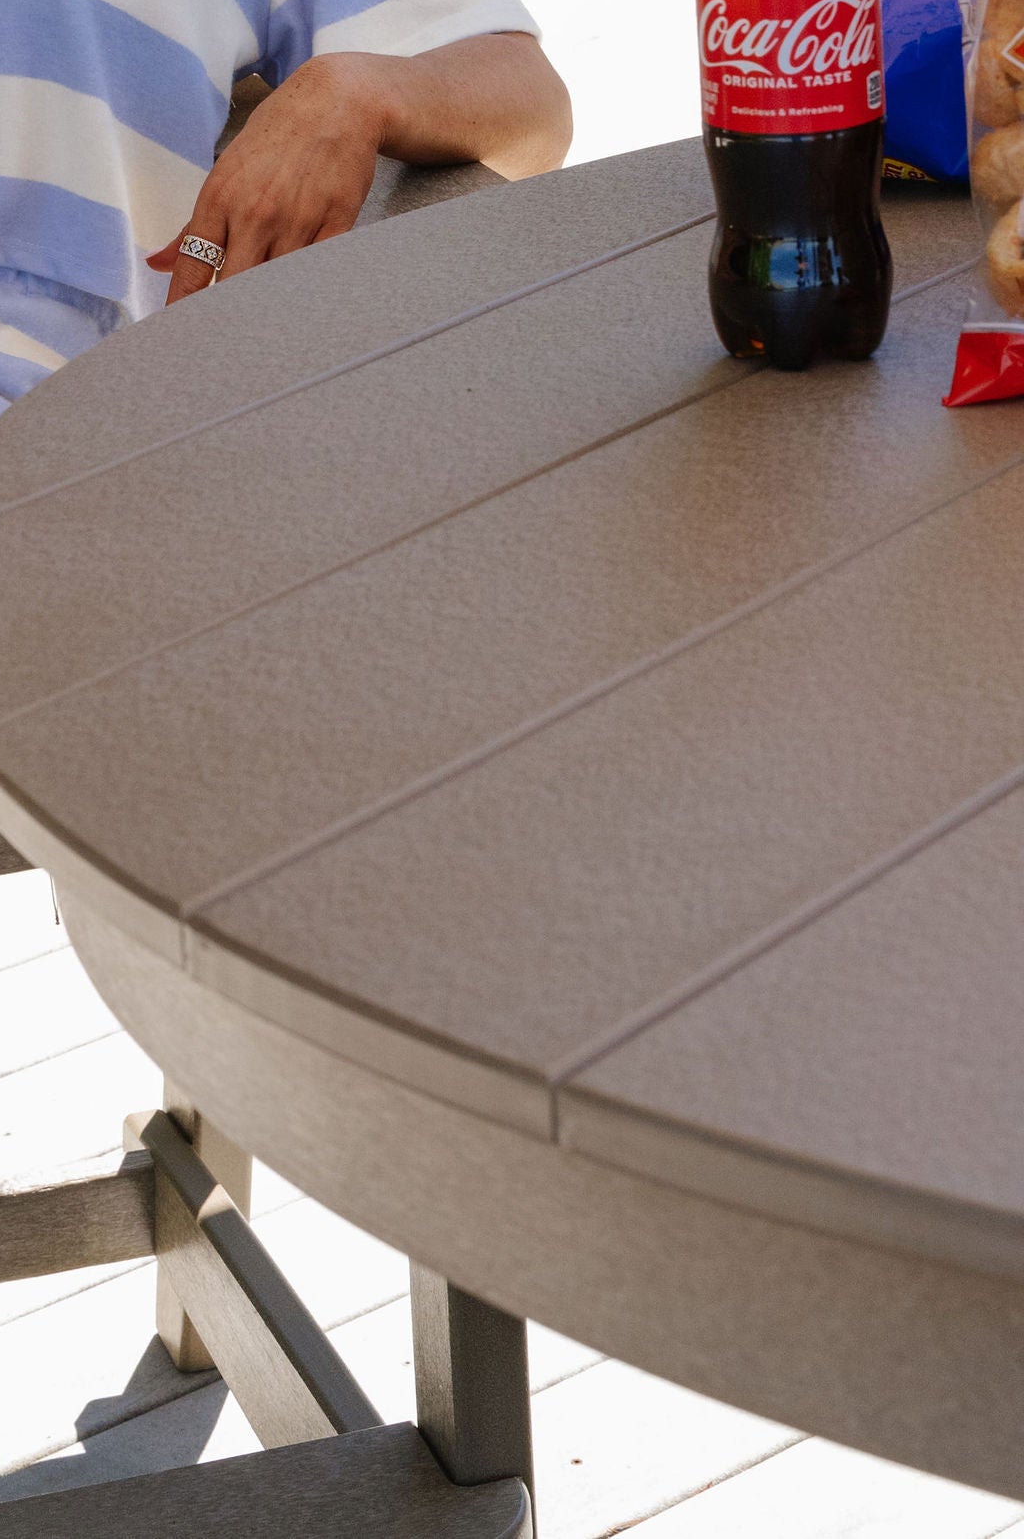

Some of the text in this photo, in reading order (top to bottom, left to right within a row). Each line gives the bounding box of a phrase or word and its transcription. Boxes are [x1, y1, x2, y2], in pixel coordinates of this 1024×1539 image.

[722, 73, 798, 89] ORIGINAL
[802, 70, 852, 88] TASTE
[731, 104, 845, 116] Delicious & Refreshing
